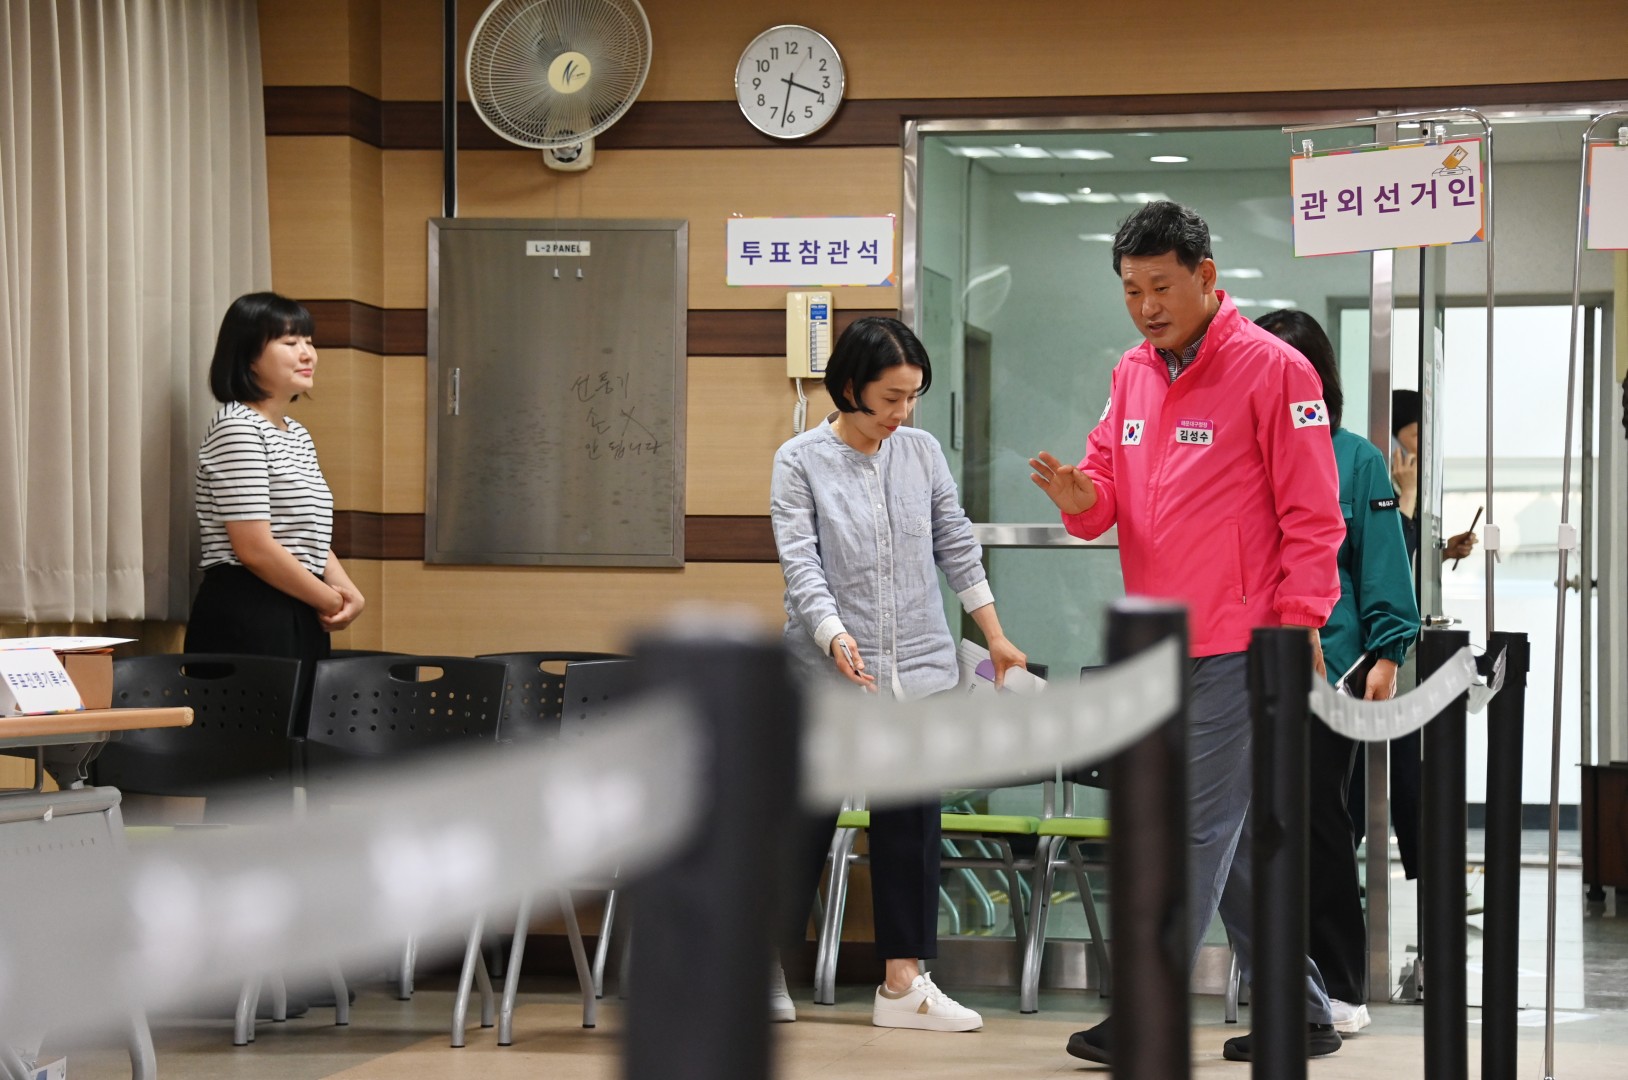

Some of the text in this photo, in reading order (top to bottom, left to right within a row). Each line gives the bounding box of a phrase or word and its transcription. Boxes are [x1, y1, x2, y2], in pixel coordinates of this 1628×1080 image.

[769, 48, 779, 60] 11
[785, 42, 799, 55] 12
[807, 47, 813, 59] 1
[755, 60, 770, 73] 10
[818, 59, 827, 71] 2
[753, 78, 761, 91] 9
[822, 76, 831, 89] 3
[757, 94, 765, 107] 8
[816, 93, 825, 105] 4
[770, 107, 778, 120] 7
[787, 111, 795, 124] 6
[805, 106, 812, 119] 5
[1299, 174, 1476, 221] 관외선거인
[535, 244, 582, 253] L-2 PANEL
[740, 239, 879, 266] 투표참관석
[1180, 429, 1209, 443] 김성수
